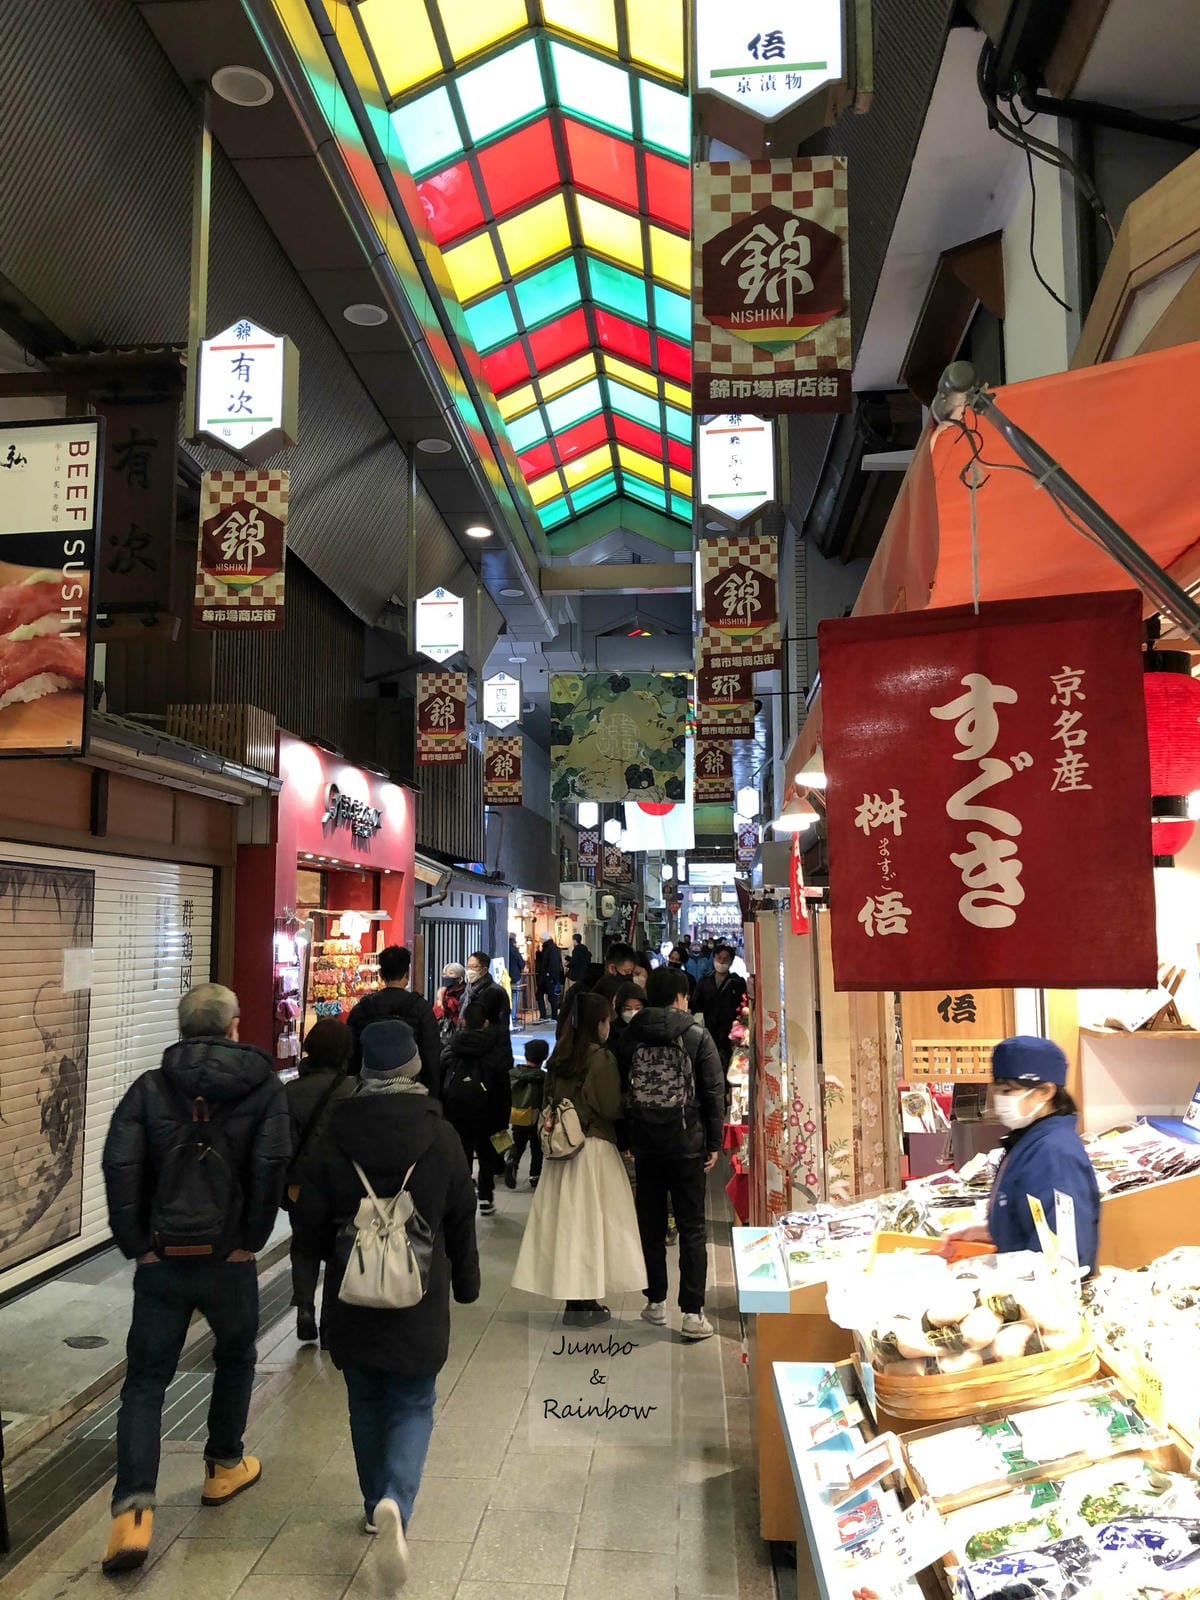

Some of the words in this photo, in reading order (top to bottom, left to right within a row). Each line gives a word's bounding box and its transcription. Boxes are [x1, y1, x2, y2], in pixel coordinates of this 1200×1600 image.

[736, 73, 802, 94] 京漬物
[720, 219, 815, 325] 錦
[730, 307, 784, 324] NISHIKI
[227, 352, 255, 415] 有次
[709, 377, 839, 399] 錦市場商店街
[66, 440, 90, 522] BEEF
[106, 427, 159, 573] 有次
[212, 508, 266, 574] 錦
[215, 562, 247, 572] NISHIKI
[59, 539, 86, 637] SUSHI
[713, 570, 762, 627] 錦
[202, 609, 276, 622] 錦市場商店街
[719, 617, 747, 626] NISHIKI
[710, 653, 775, 669] 錦市場商店街
[424, 696, 456, 733] 錦
[1049, 665, 1093, 793] 京名産
[490, 753, 514, 781] 錦
[700, 749, 726, 778] 錦
[929, 673, 1034, 929] すぐき
